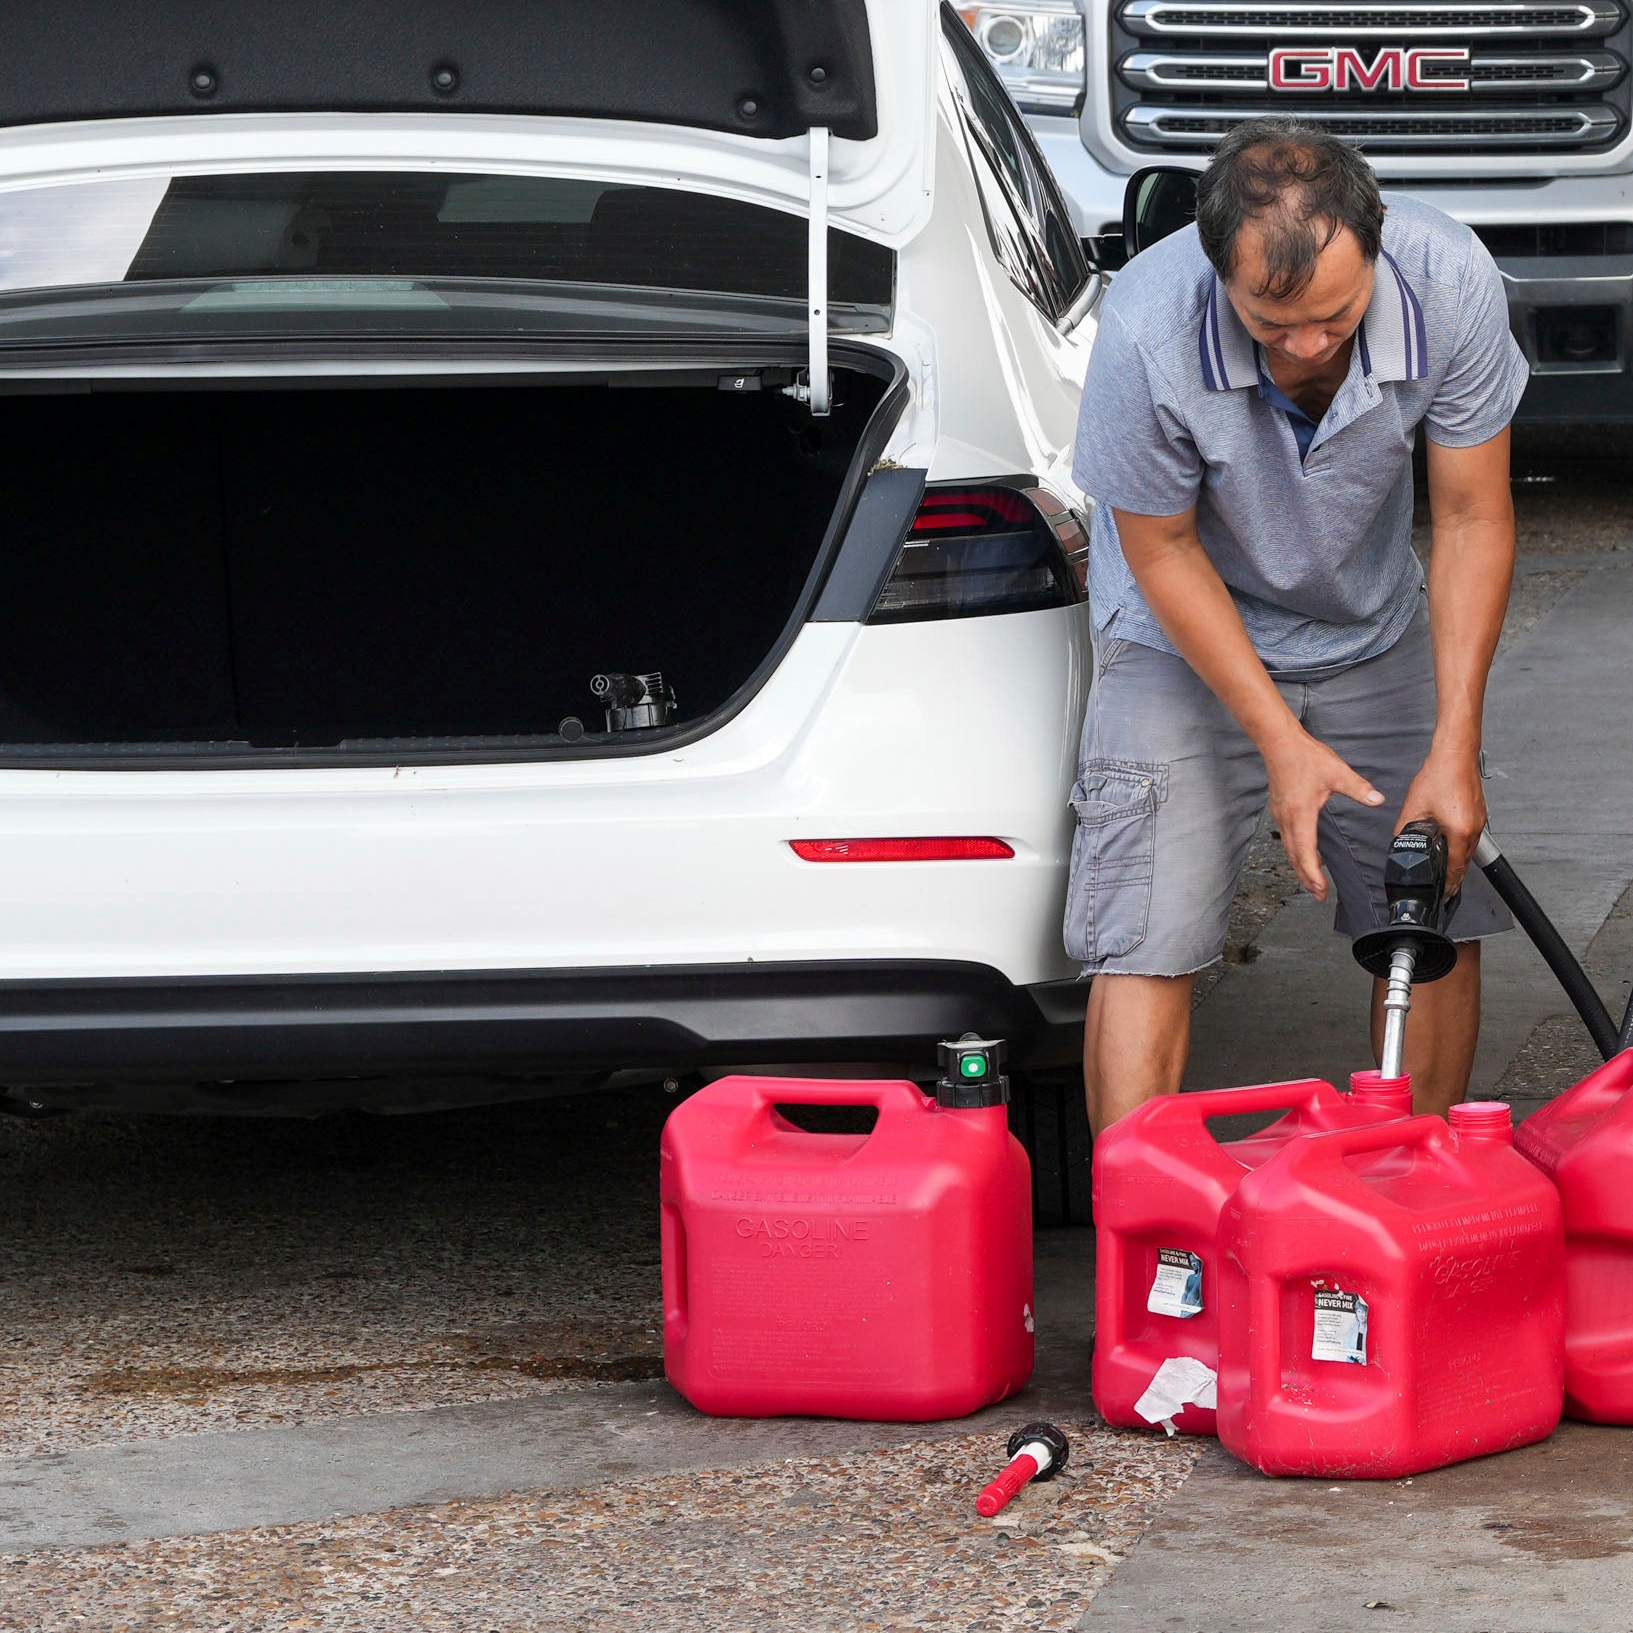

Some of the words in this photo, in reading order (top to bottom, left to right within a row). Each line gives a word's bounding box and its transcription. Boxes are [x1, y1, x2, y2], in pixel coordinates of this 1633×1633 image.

[1269, 47, 1469, 91] GMC
[1393, 841, 1427, 849] WARNING
[736, 1217, 869, 1241] GASOLINE
[760, 1241, 840, 1259] DANGER
[1161, 1254, 1179, 1263] NEVER
[1180, 1257, 1189, 1266] MIX
[1318, 1298, 1341, 1308] NEVER
[1342, 1301, 1354, 1310] MIX
